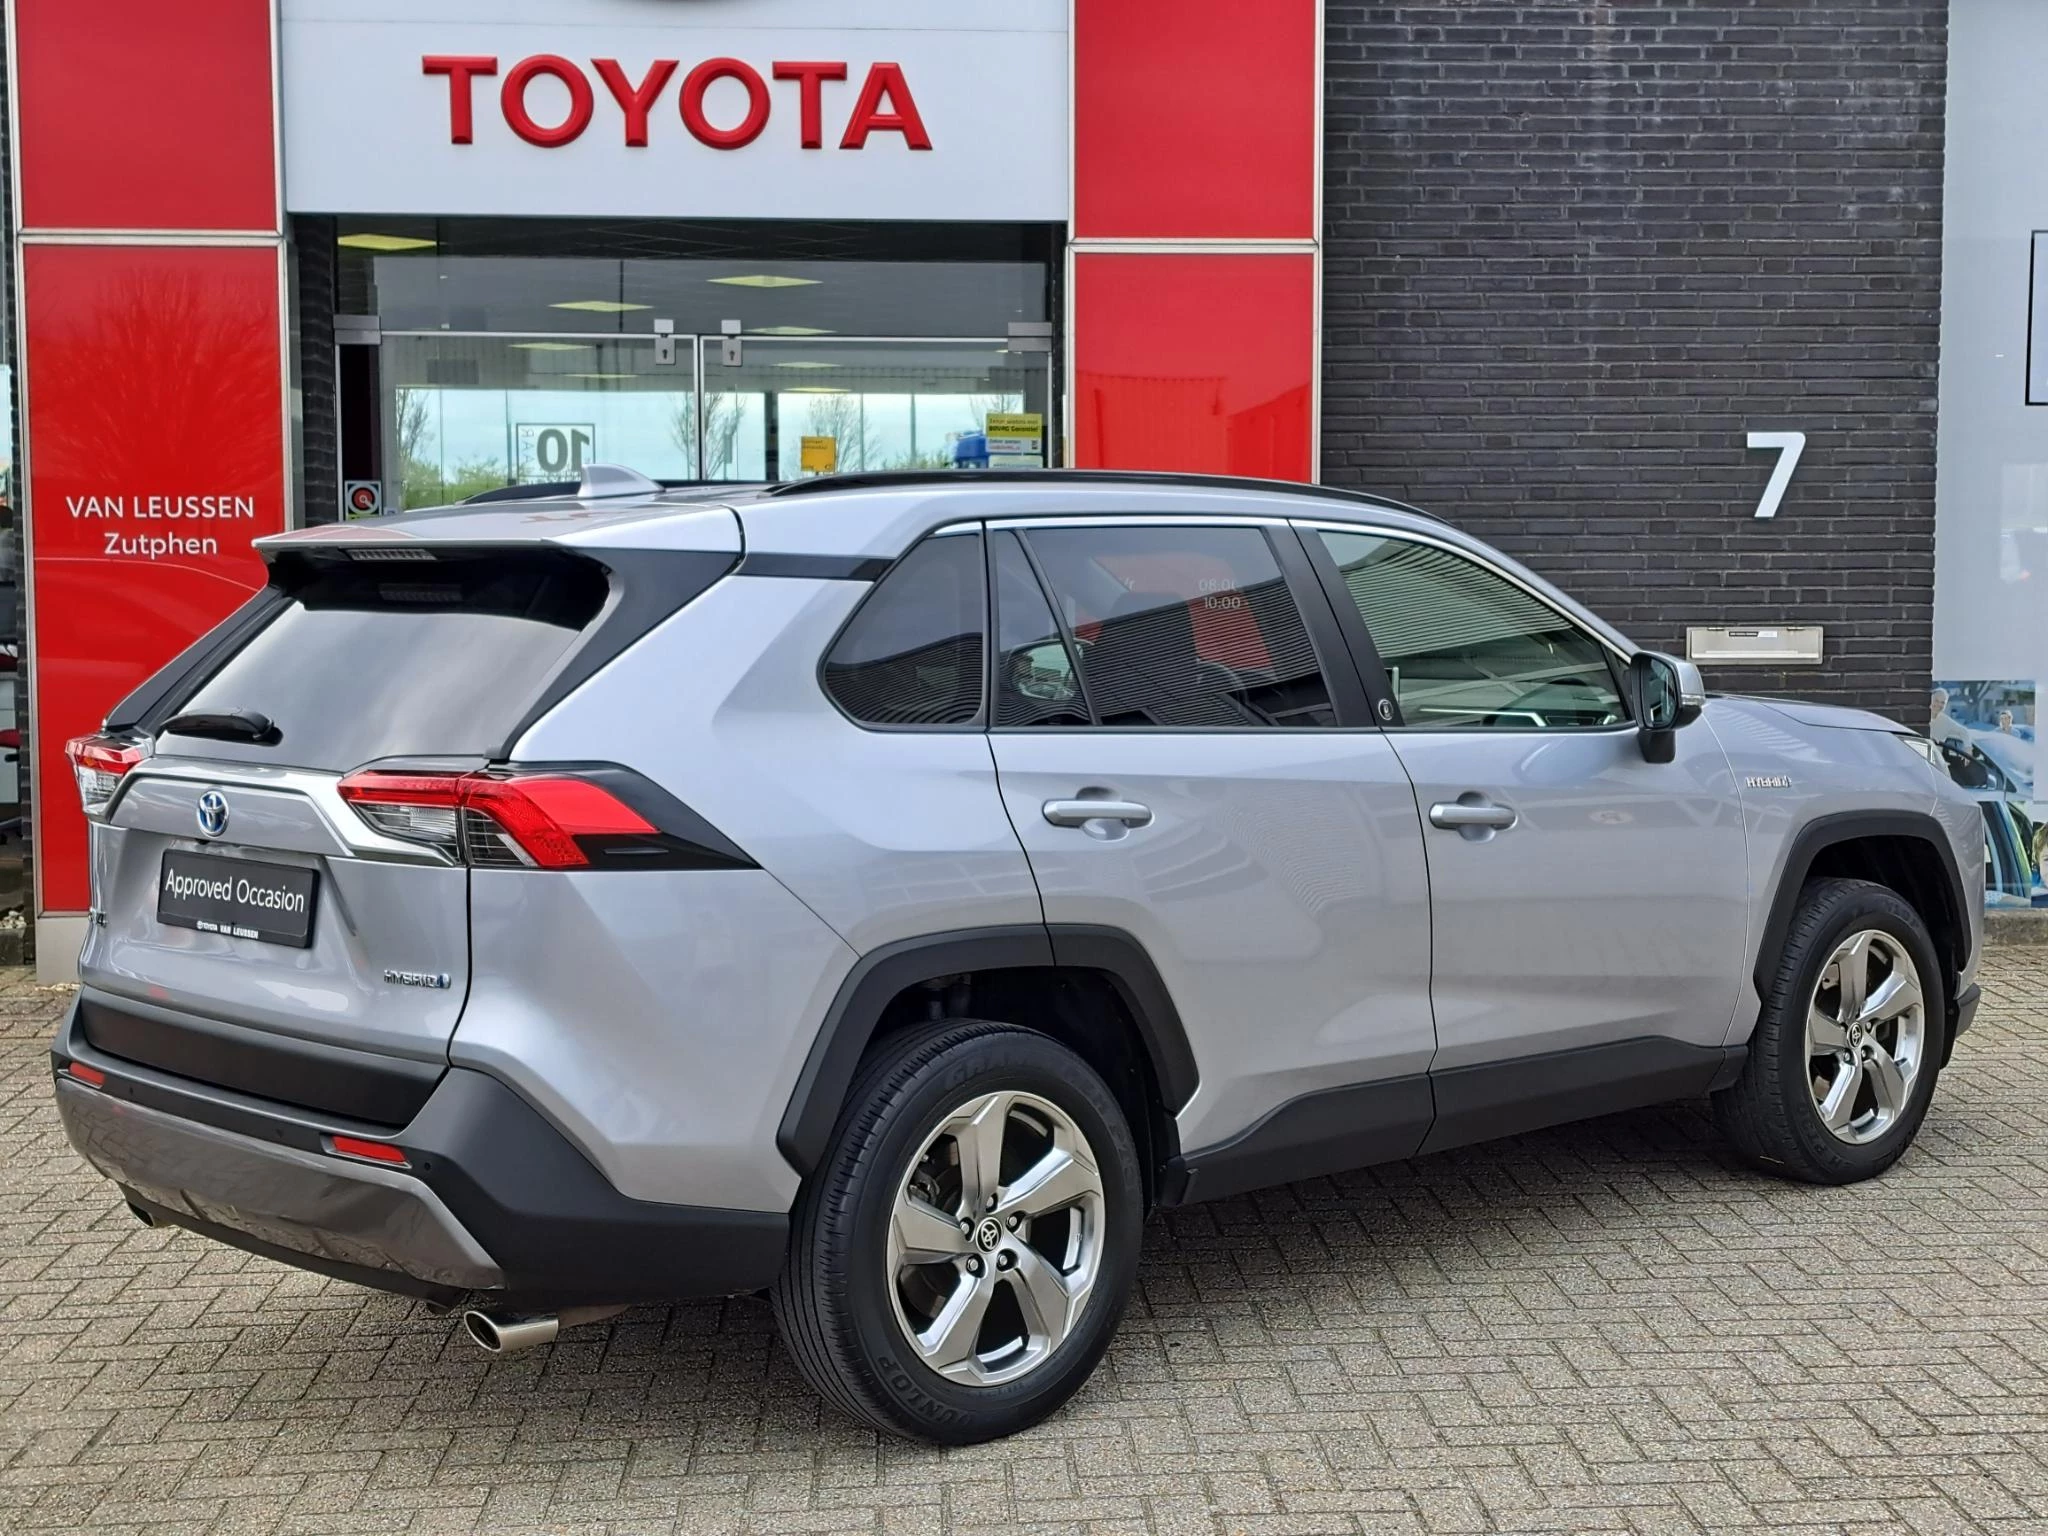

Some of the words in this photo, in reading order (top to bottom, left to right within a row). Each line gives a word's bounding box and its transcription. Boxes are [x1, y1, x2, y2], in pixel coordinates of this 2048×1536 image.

[422, 54, 933, 150] TOYOTA
[1747, 432, 1806, 518] 7
[65, 496, 123, 518] VAN
[133, 496, 254, 518] LEUSSEN
[104, 531, 217, 560] Zutphen
[165, 868, 232, 900] Approved
[236, 879, 304, 912] Occasion
[383, 969, 438, 988] HYBRID
